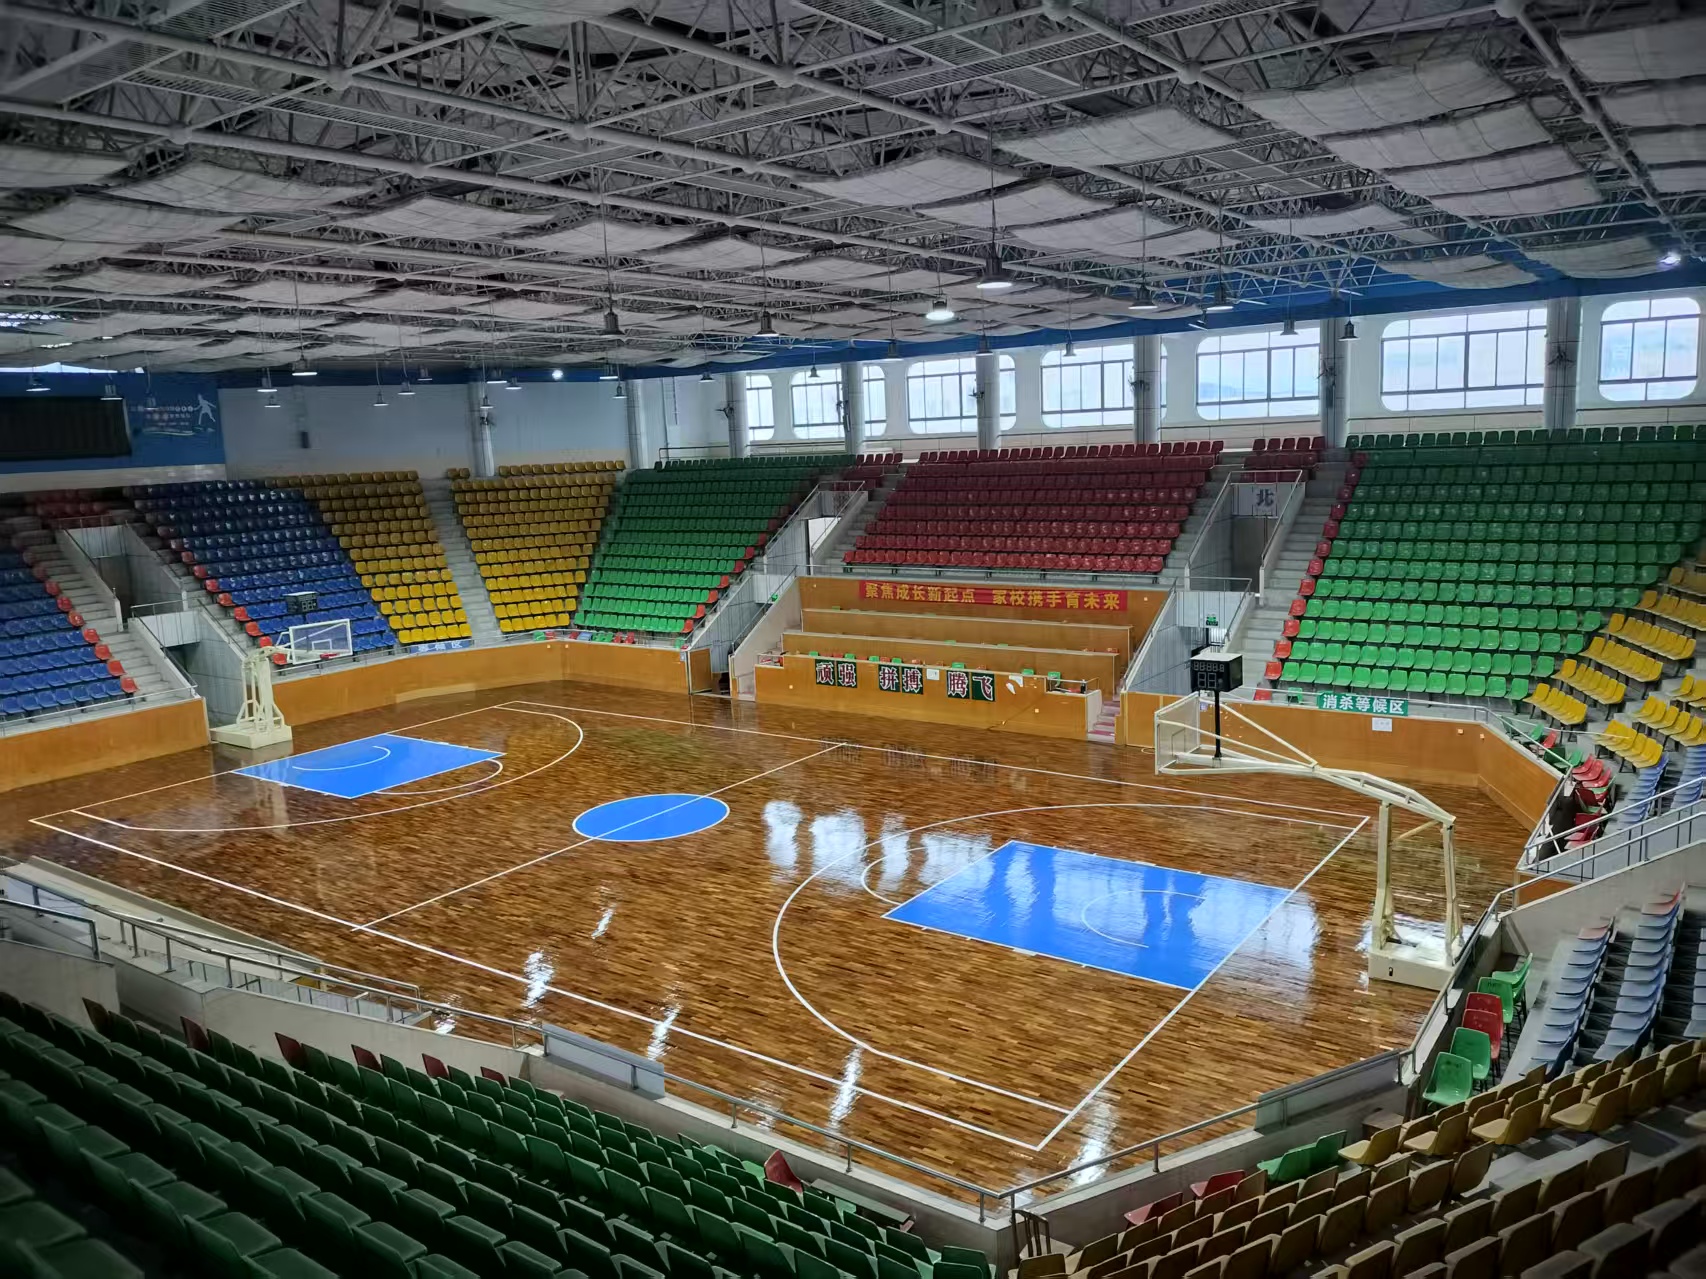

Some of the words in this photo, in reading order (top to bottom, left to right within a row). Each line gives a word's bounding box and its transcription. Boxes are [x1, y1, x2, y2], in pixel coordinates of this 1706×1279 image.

[1256, 488, 1274, 507] 北
[865, 582, 976, 603] 聚焦成长新起点
[992, 589, 1120, 610] 家校携手育未来
[816, 661, 857, 687] 顽强
[879, 667, 922, 693] 拼搏
[947, 671, 994, 701] 腾飞
[1322, 694, 1405, 714] 消杀等候区
